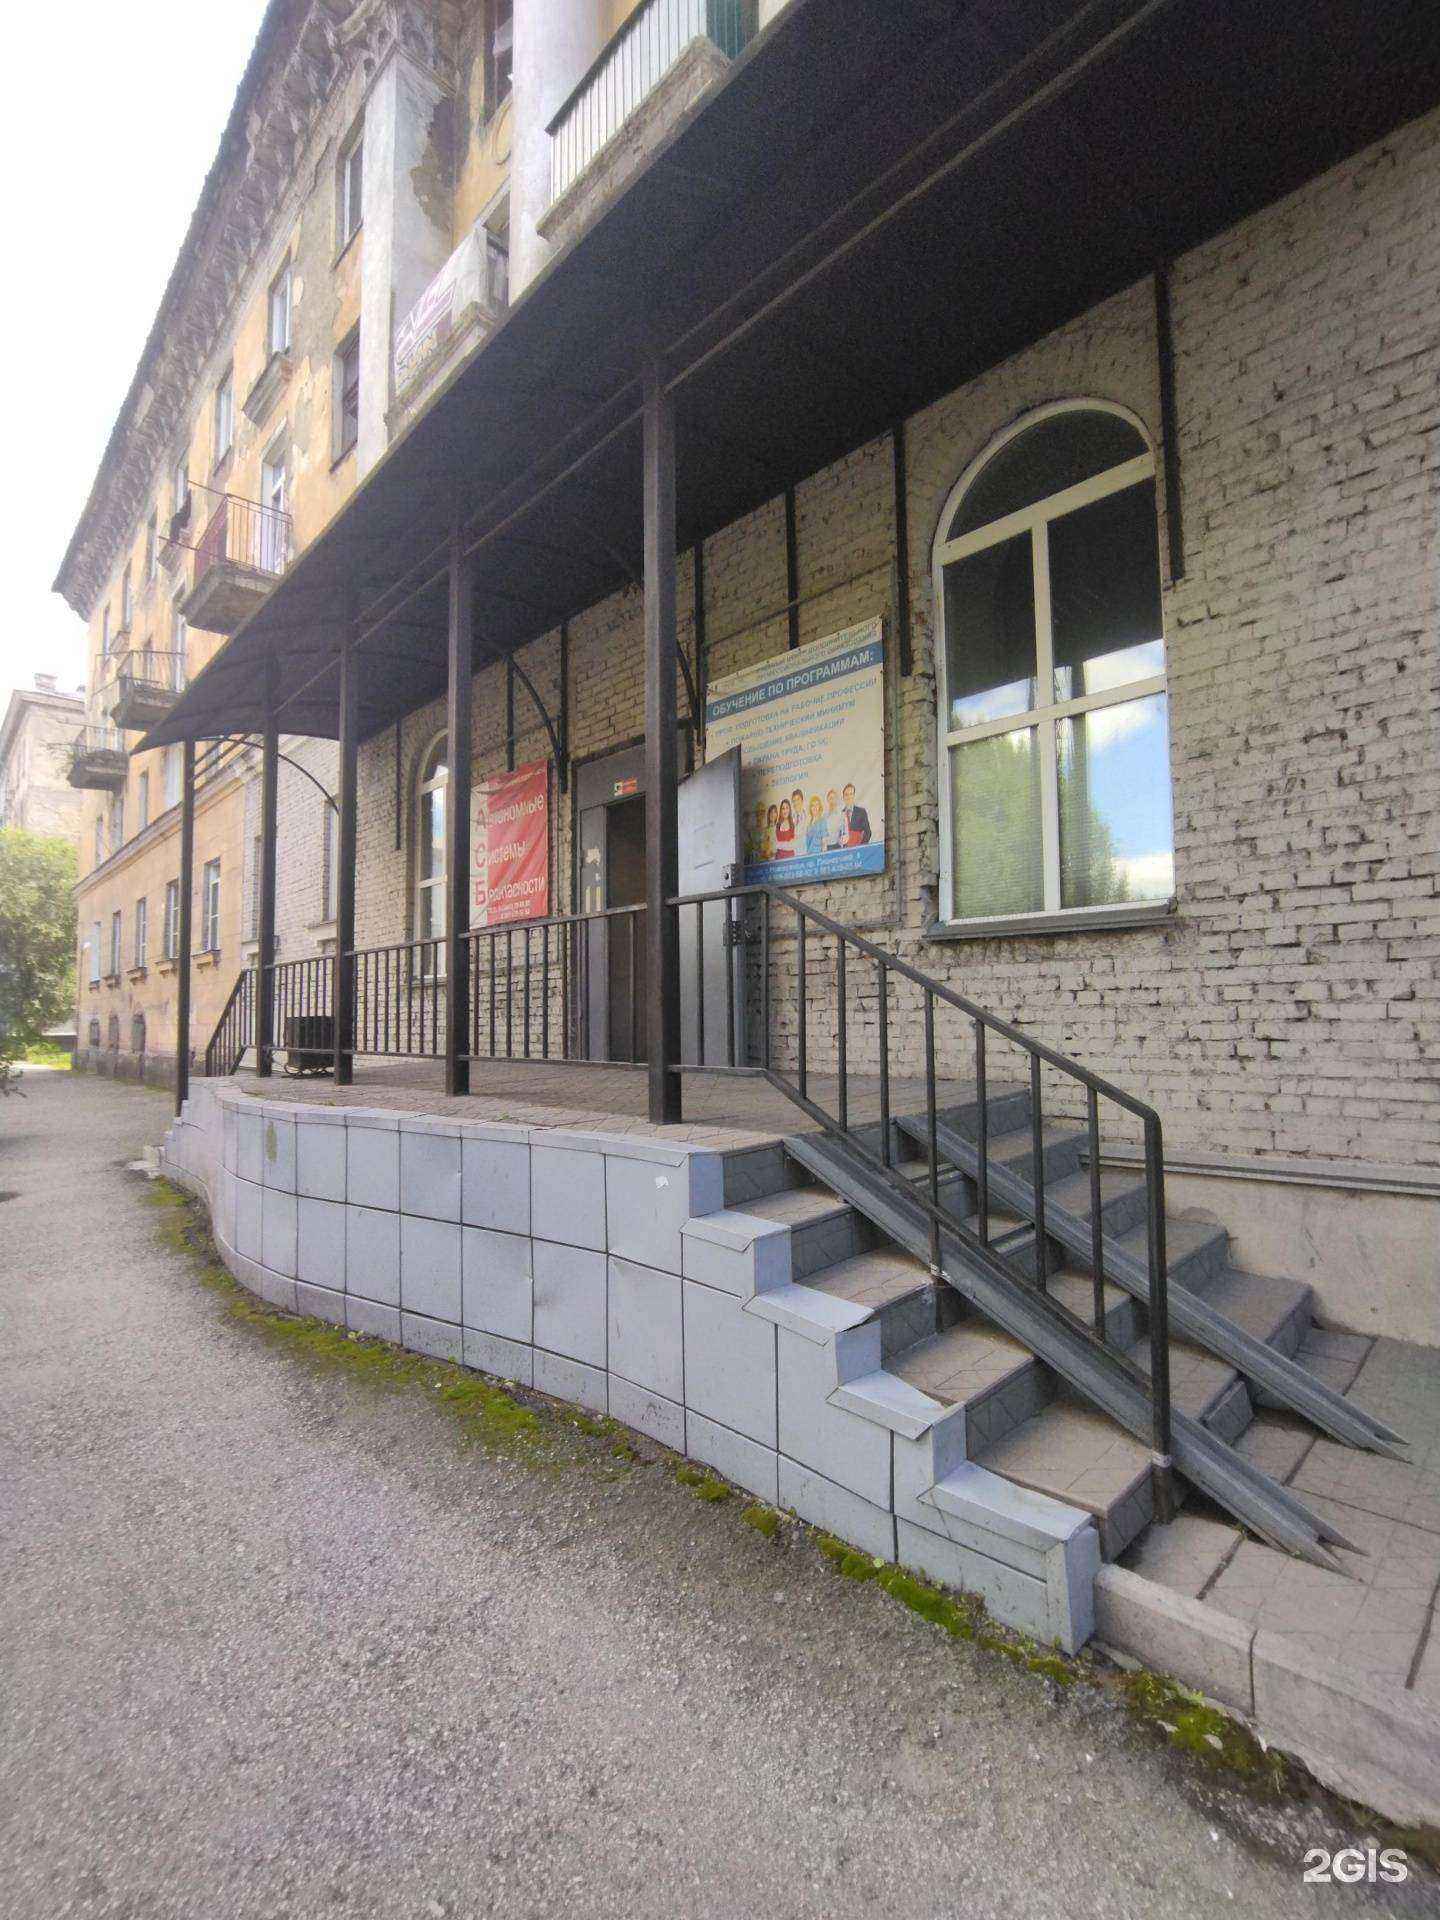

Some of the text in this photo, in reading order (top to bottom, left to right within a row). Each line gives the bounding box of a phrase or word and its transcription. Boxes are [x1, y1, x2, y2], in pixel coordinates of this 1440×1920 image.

[712, 650, 873, 716] ОБУЧЕНИЕ ПО ПРОГРАММАМ:
